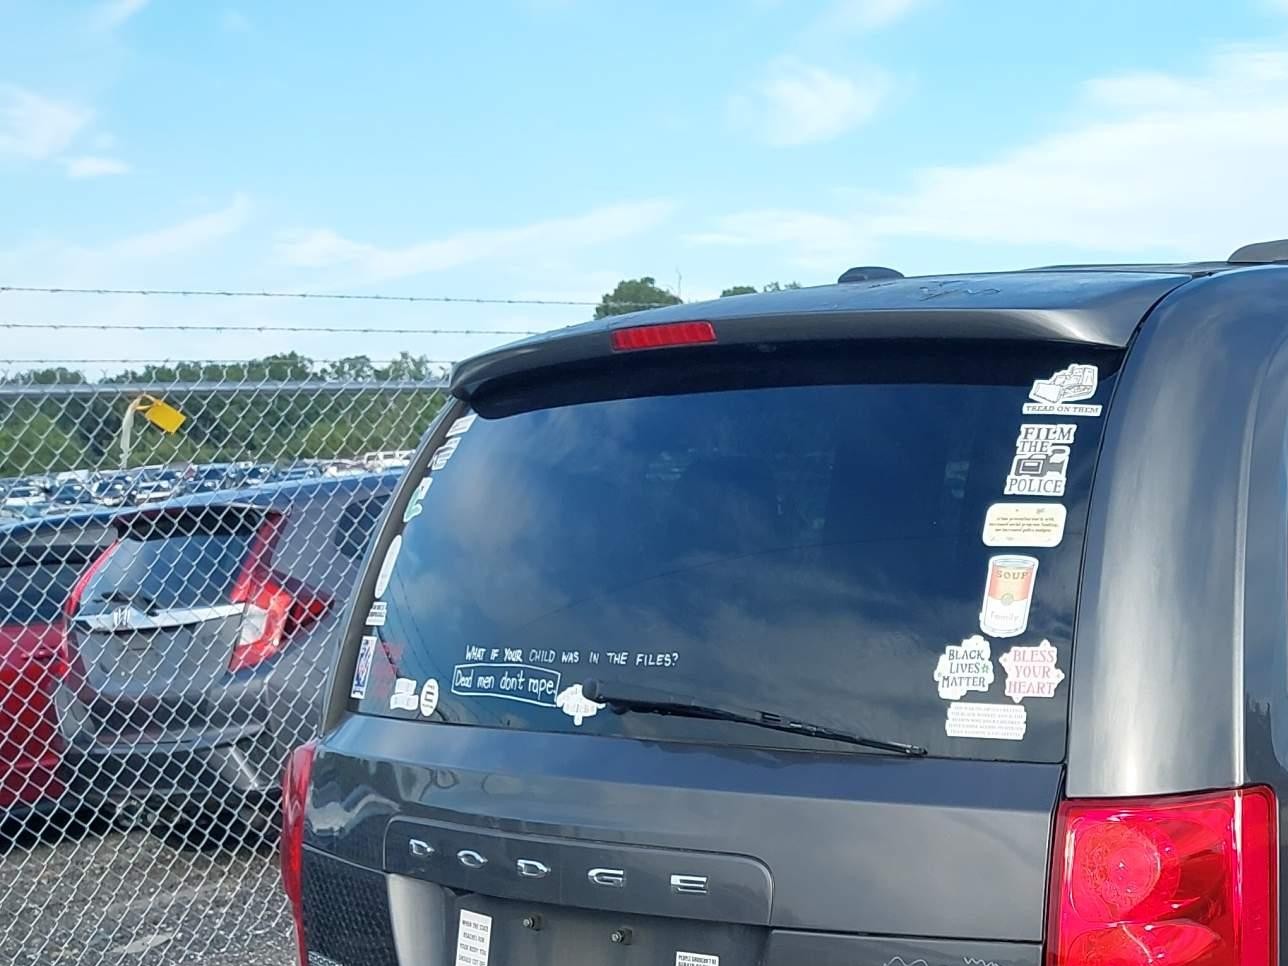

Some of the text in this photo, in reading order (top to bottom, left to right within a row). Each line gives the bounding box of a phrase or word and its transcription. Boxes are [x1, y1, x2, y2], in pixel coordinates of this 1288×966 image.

[1071, 406, 1099, 414] THEM
[1023, 426, 1072, 441] FILM
[1019, 440, 1050, 453] THE
[1007, 477, 1063, 494] POLICE
[996, 568, 1028, 580] SOUP
[465, 645, 679, 667] WHAT IF YOUR CHILD WAS IN THE FILES?
[948, 649, 985, 661] BLACK
[1013, 649, 1055, 663] BLESS
[949, 662, 981, 674] LIVES
[1014, 665, 1050, 679] YOUR
[455, 669, 474, 688] Dead
[477, 675, 495, 689] men
[500, 670, 525, 691] don't
[941, 675, 986, 688] MATTER
[1007, 681, 1056, 694] HEART
[408, 838, 708, 895] DODGE
